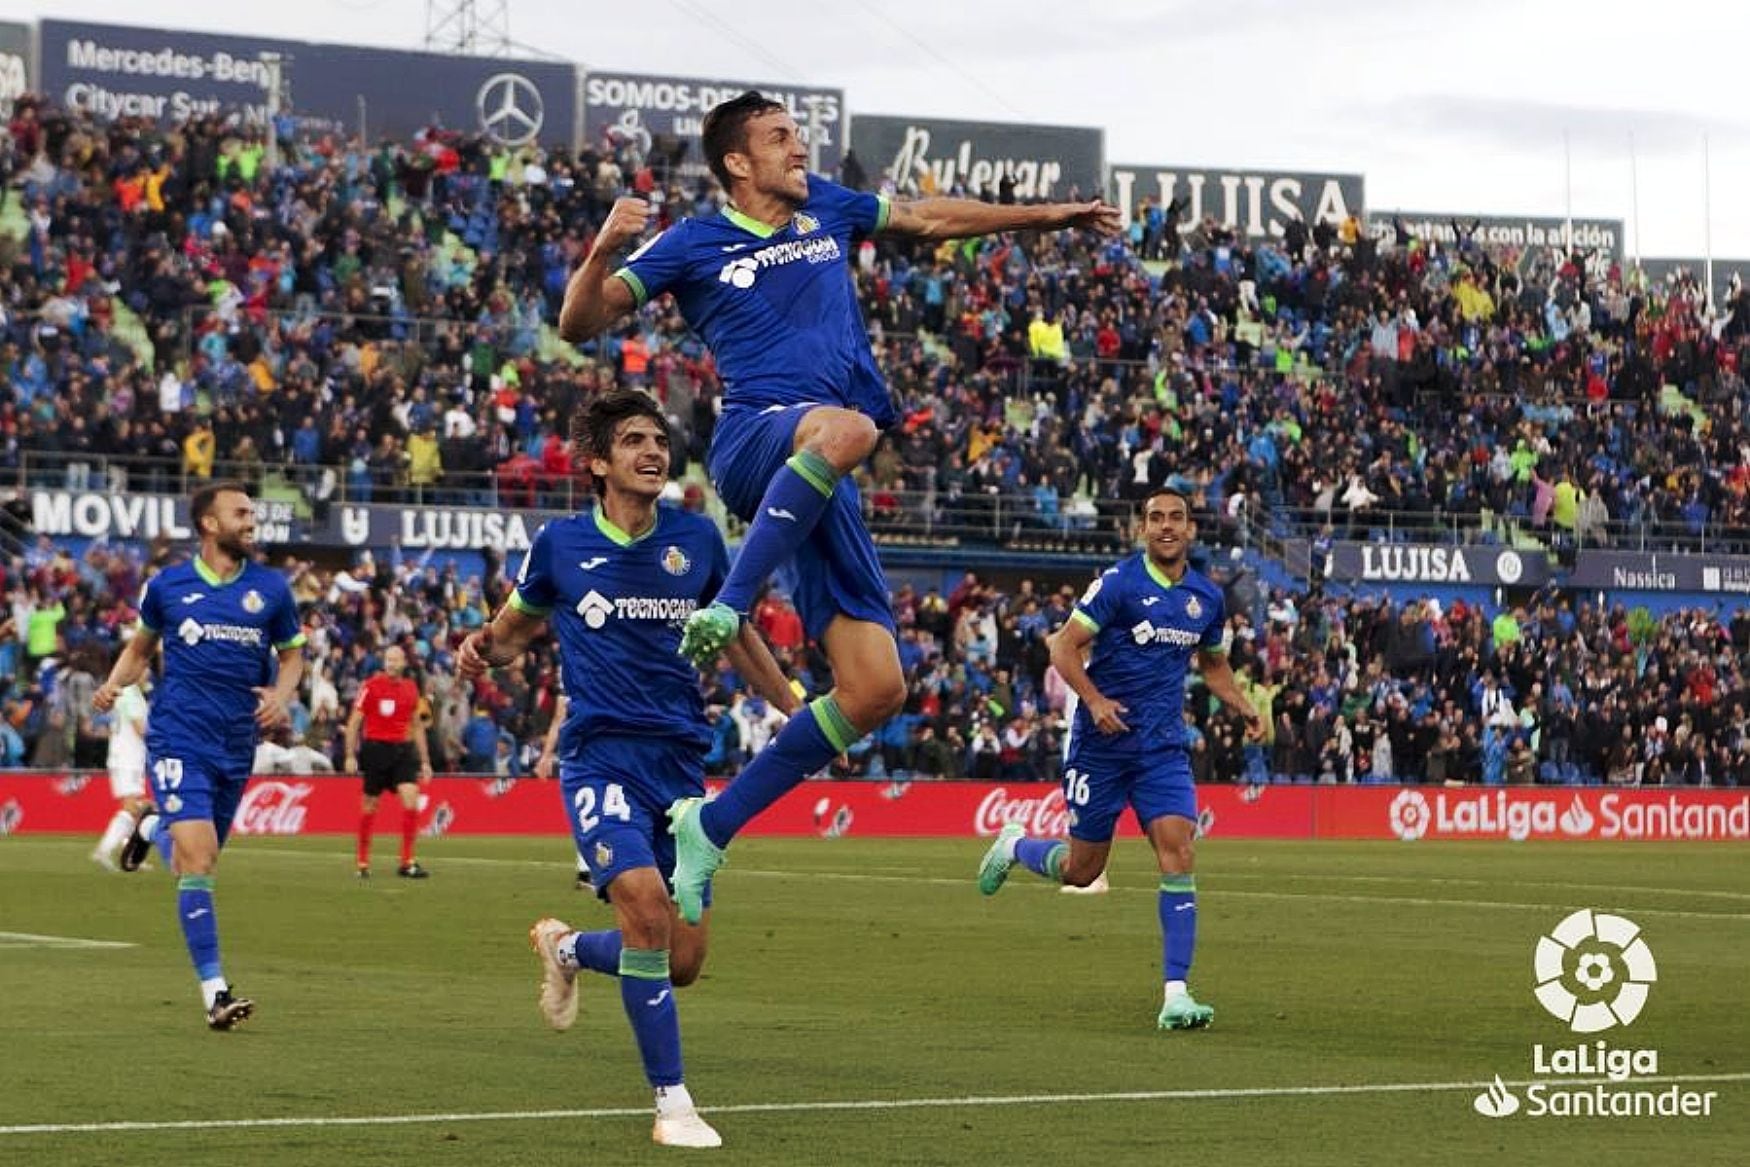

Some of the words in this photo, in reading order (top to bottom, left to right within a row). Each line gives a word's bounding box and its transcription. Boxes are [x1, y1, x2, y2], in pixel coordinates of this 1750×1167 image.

[67, 39, 270, 88] Mercedes-Ben
[66, 83, 167, 121] Citycar
[1489, 225, 1524, 245] con
[1527, 221, 1546, 245] la
[1548, 222, 1615, 248] afción
[33, 491, 192, 540] MOVIL
[402, 508, 530, 549] LUJISA
[1362, 545, 1471, 582] LUJISA
[1613, 565, 1676, 590] Nassica
[153, 757, 184, 791] 19
[1065, 768, 1090, 806] 16
[575, 782, 631, 834] 24
[1436, 789, 1557, 841] LaLiga
